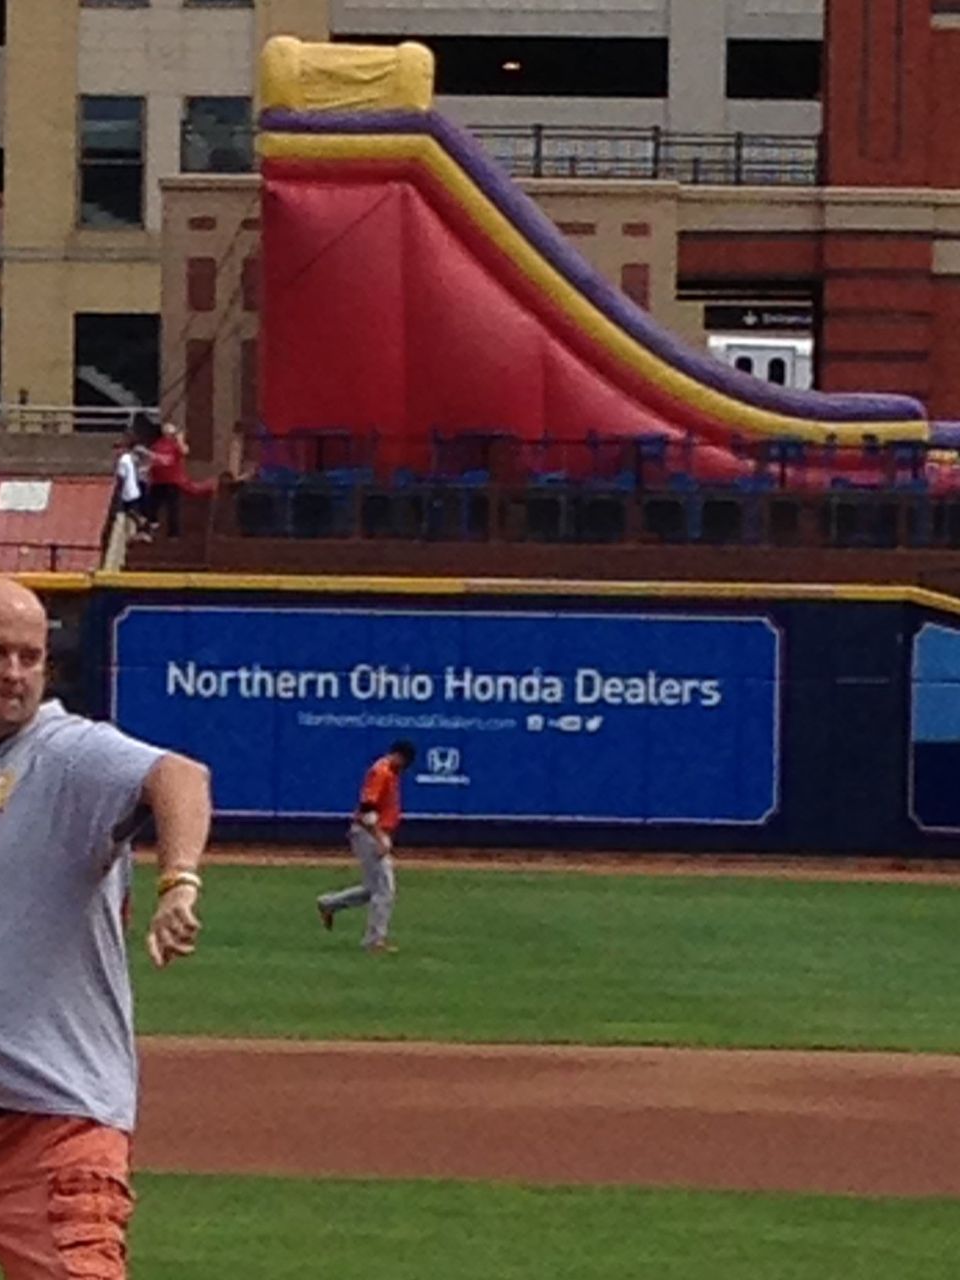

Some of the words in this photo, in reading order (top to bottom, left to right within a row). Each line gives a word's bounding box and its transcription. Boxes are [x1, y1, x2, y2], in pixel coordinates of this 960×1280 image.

[166, 660, 339, 698] Northern
[350, 663, 433, 700] Ohio
[444, 665, 564, 703] Honda
[574, 667, 721, 706] Dealers
